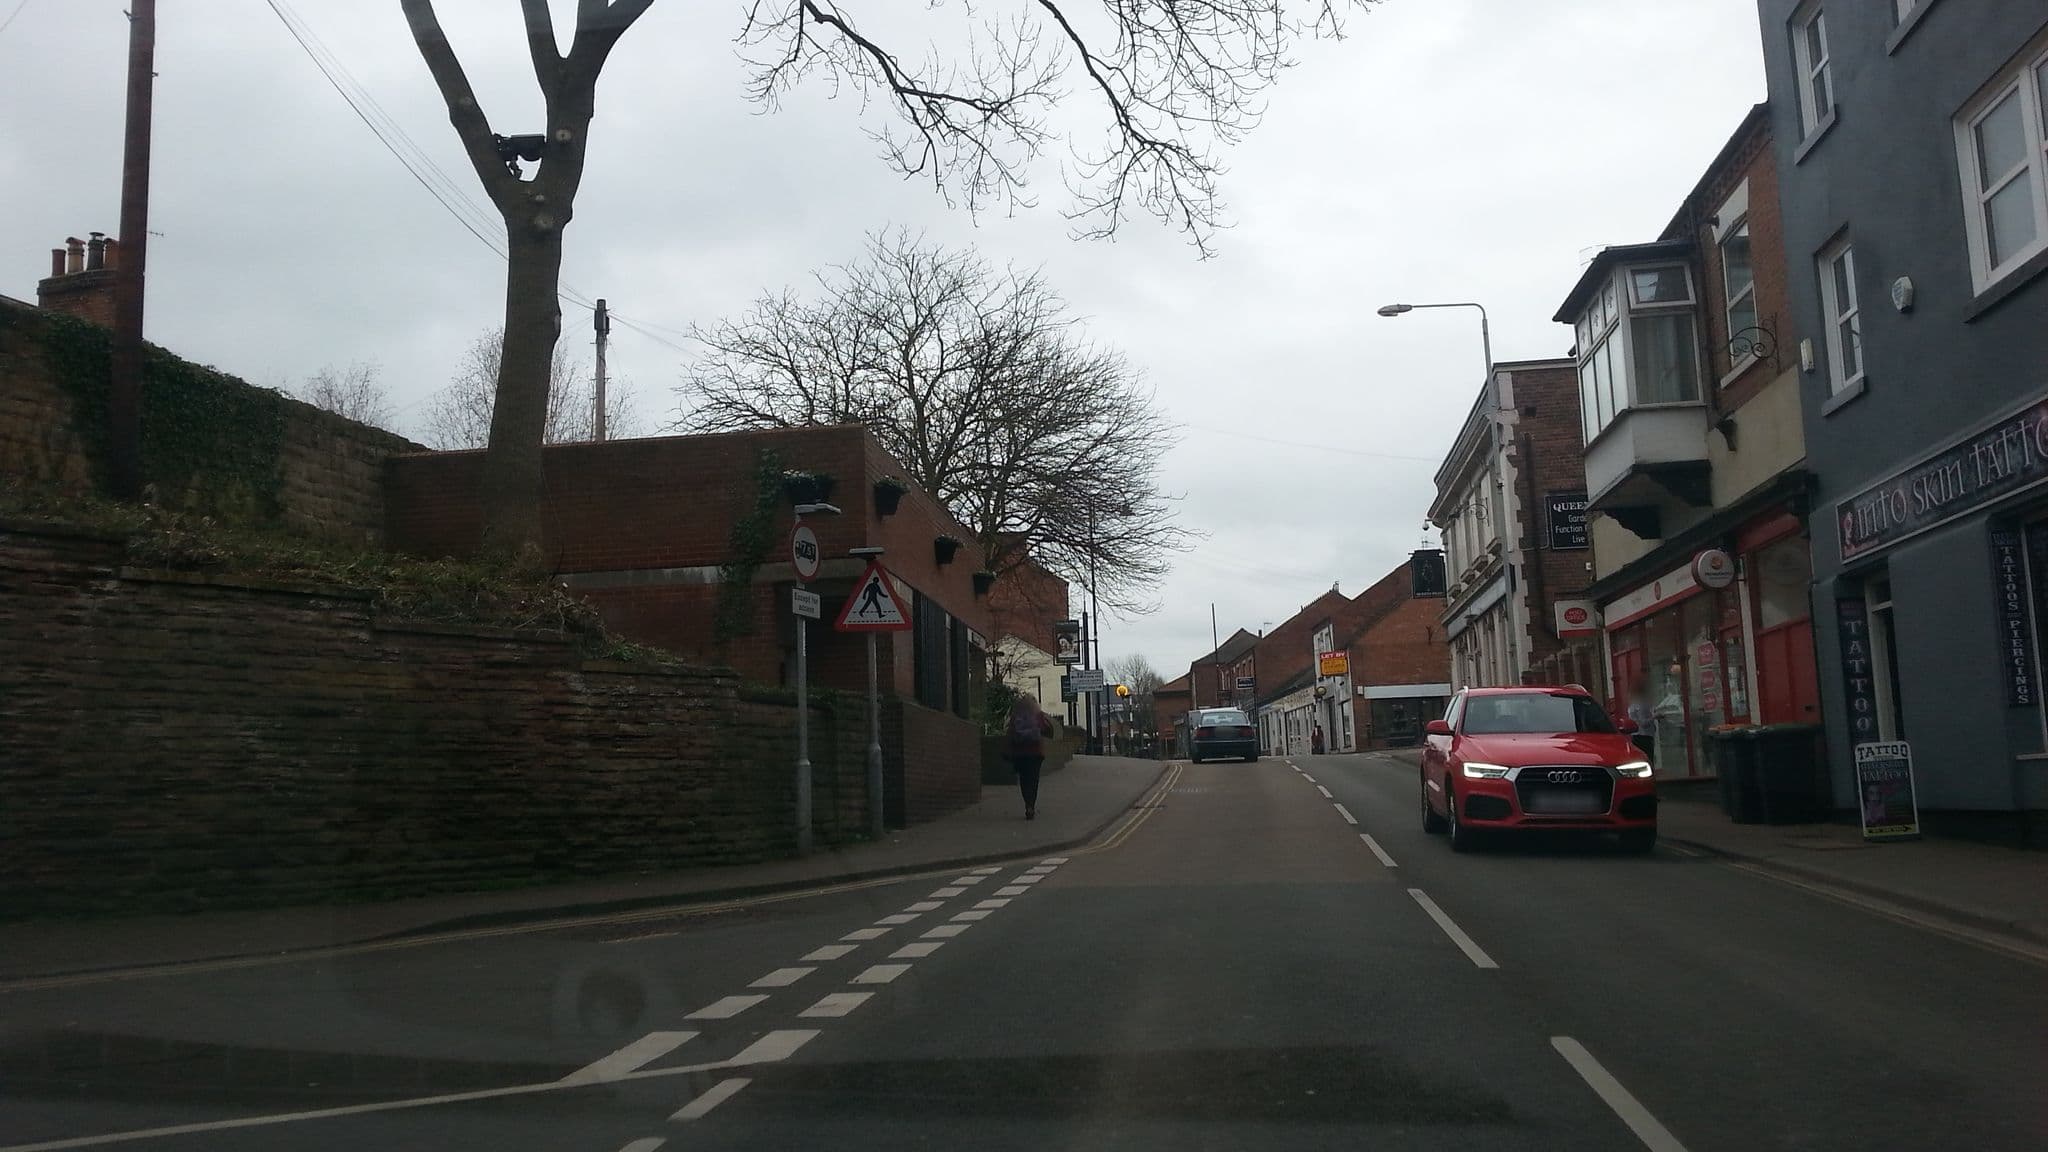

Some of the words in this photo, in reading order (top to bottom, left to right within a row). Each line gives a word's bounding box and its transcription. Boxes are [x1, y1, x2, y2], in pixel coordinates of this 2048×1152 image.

[1553, 501, 1589, 512] QUEE
[1555, 525, 1583, 534] Function
[1572, 535, 1585, 543] Live
[2001, 546, 2019, 611] TATTOOS
[2009, 621, 2029, 704] PIERCINGS
[1845, 619, 1872, 731] TATTOO
[1857, 745, 1908, 760] TATTOO
